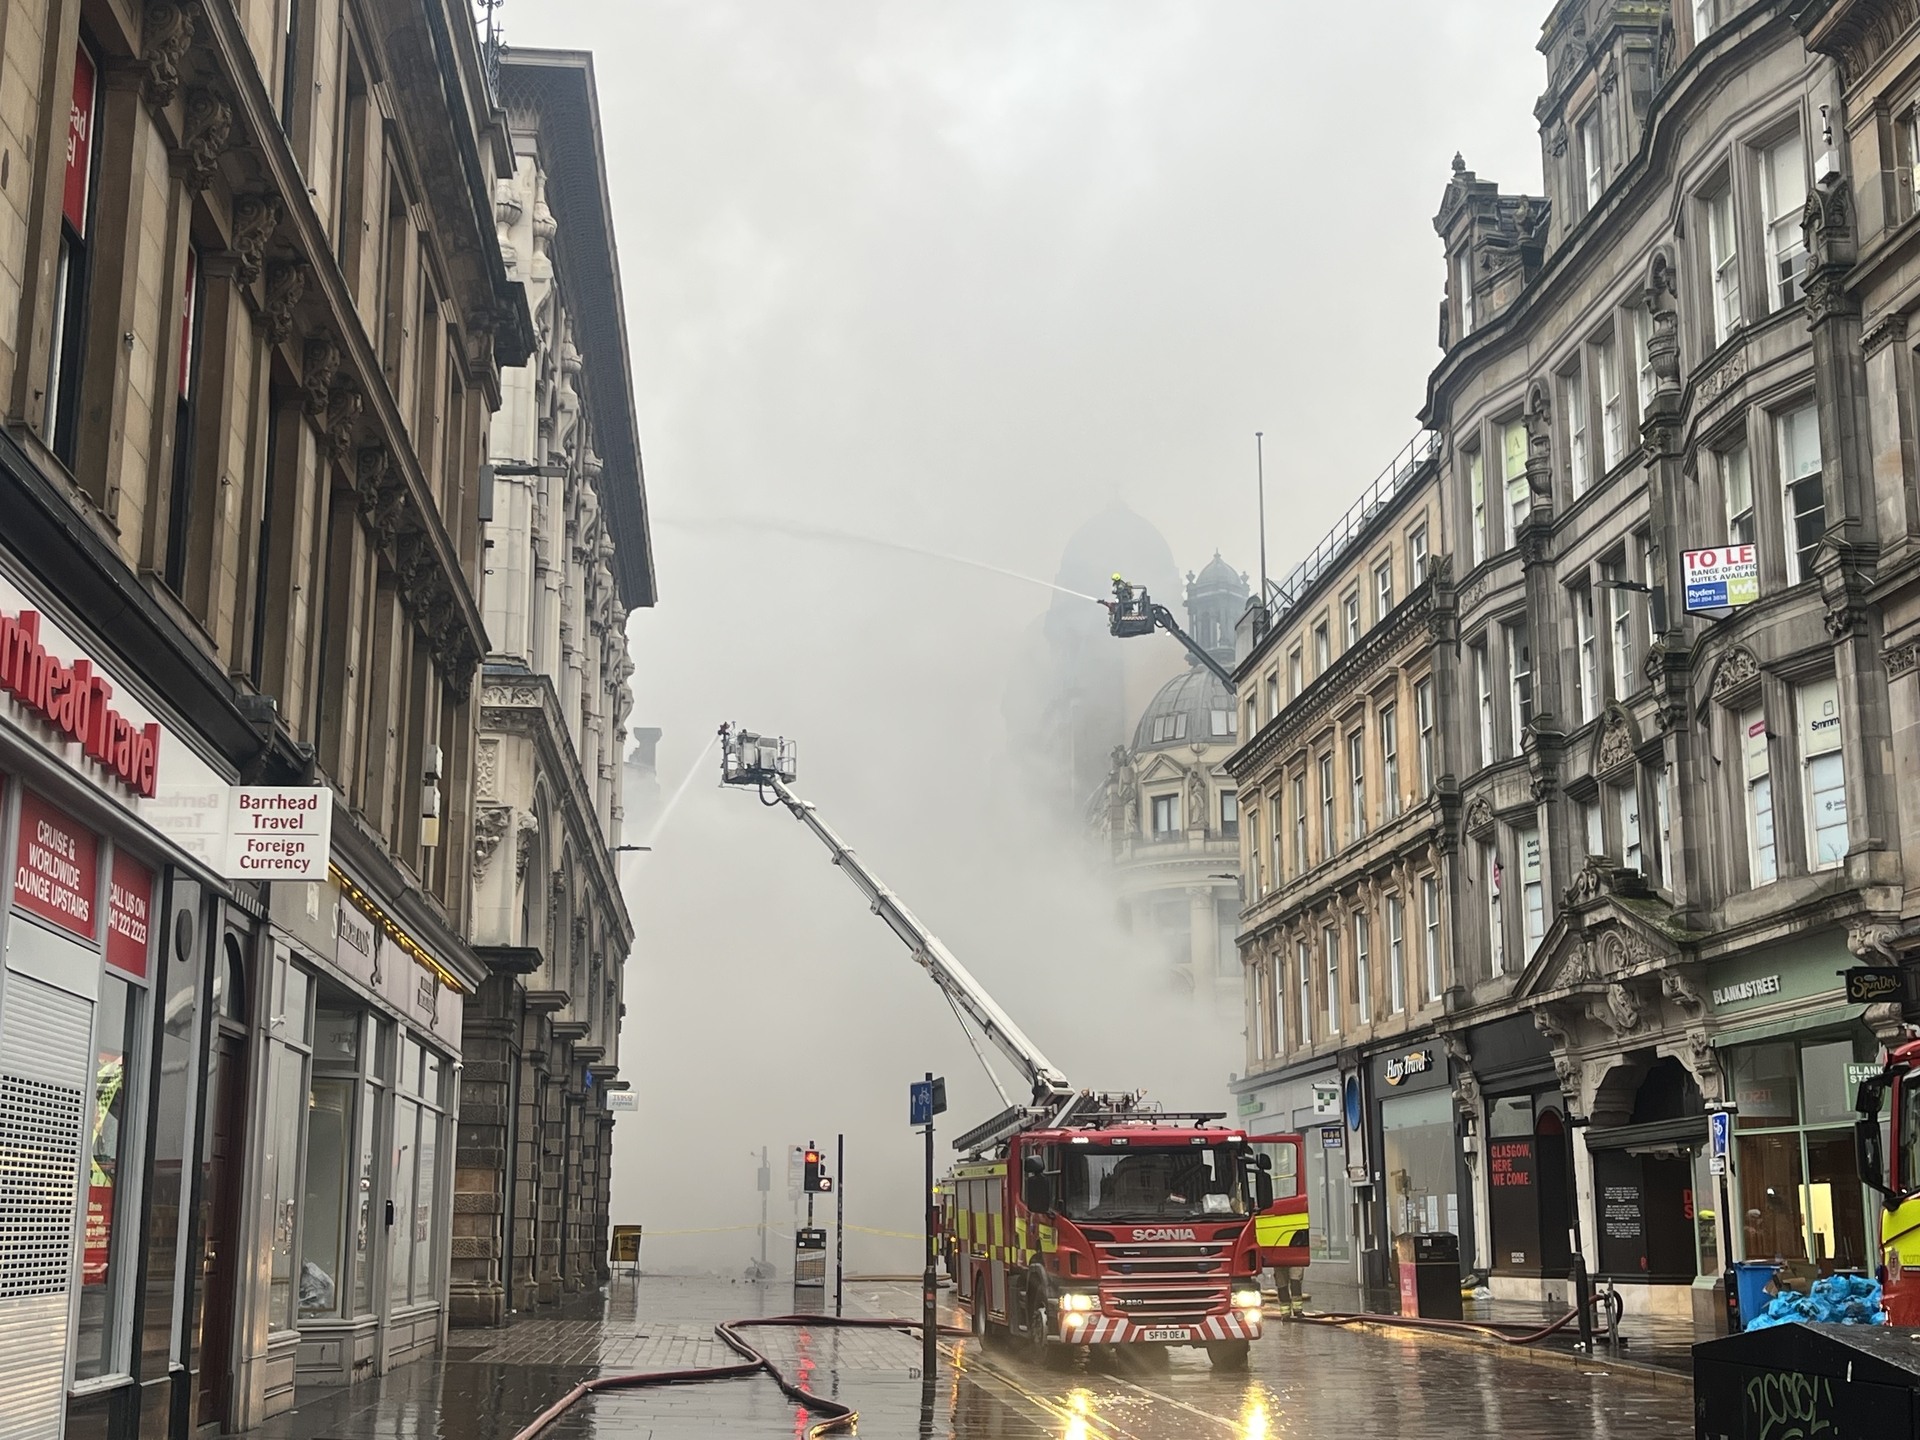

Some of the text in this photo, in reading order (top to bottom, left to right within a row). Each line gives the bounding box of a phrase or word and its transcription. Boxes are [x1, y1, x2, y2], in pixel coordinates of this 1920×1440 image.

[1685, 546, 1755, 569] TO LE
[1690, 571, 1757, 583] SUITES AVAILAB
[1691, 567, 1719, 577] RANGE
[1689, 588, 1716, 598] Ryden
[0, 608, 161, 799] rrhead Travel
[239, 794, 318, 810] Barrhead
[252, 814, 304, 829] Travel
[37, 819, 76, 861] CRUISE &
[247, 839, 305, 856] Foreign
[28, 842, 81, 891] WORLDWIDE
[240, 855, 311, 873] Currency
[14, 866, 89, 922] OUNGE UPSTAIRS
[125, 891, 136, 914] US
[135, 897, 146, 920] ON
[118, 914, 130, 937] 222
[131, 923, 147, 945] 2223
[1712, 975, 1780, 1005] BLANK STREET
[1387, 1050, 1425, 1078] Hays Travel
[1849, 1066, 1884, 1075] BLANK
[1491, 1144, 1532, 1159] GLASGOW,
[1492, 1159, 1513, 1172] HERE
[1493, 1172, 1531, 1186] WE COME.
[1132, 1228, 1196, 1241] SCANIA
[1149, 1331, 1186, 1339] SF19 OEA
